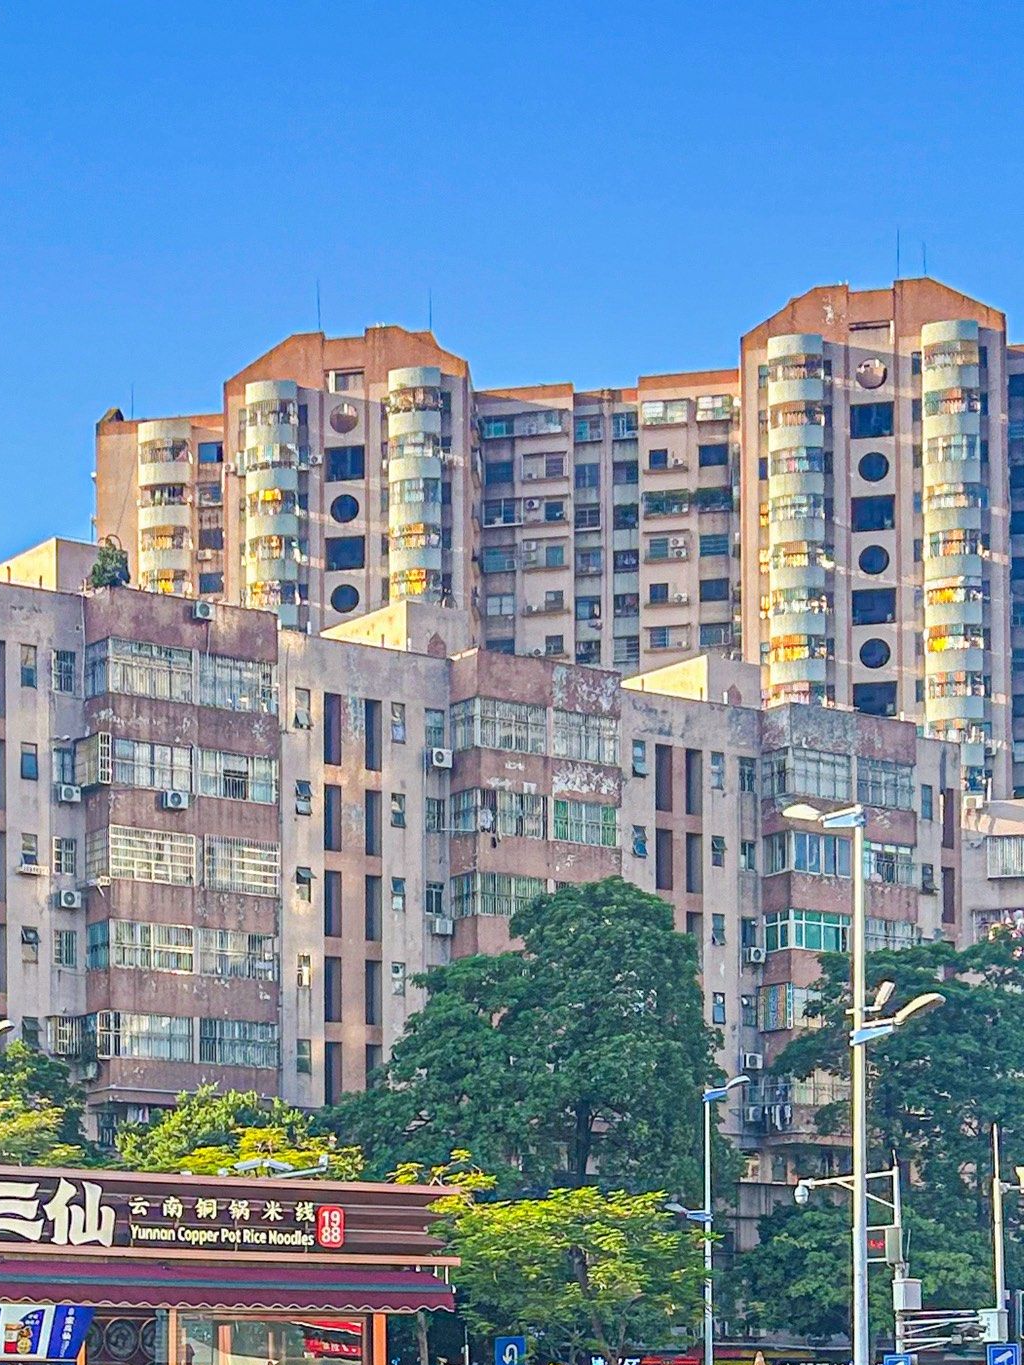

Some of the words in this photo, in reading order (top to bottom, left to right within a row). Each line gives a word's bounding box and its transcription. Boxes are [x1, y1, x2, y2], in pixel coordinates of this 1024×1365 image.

[128, 1196, 316, 1223] 云南铜锅米线
[321, 1211, 340, 1227] 19
[130, 1224, 176, 1242] Yunnan
[177, 1225, 220, 1245] Copper
[221, 1229, 241, 1244] Pot
[243, 1230, 267, 1244] Rice
[268, 1230, 315, 1246] Noodles
[321, 1228, 341, 1243] 88
